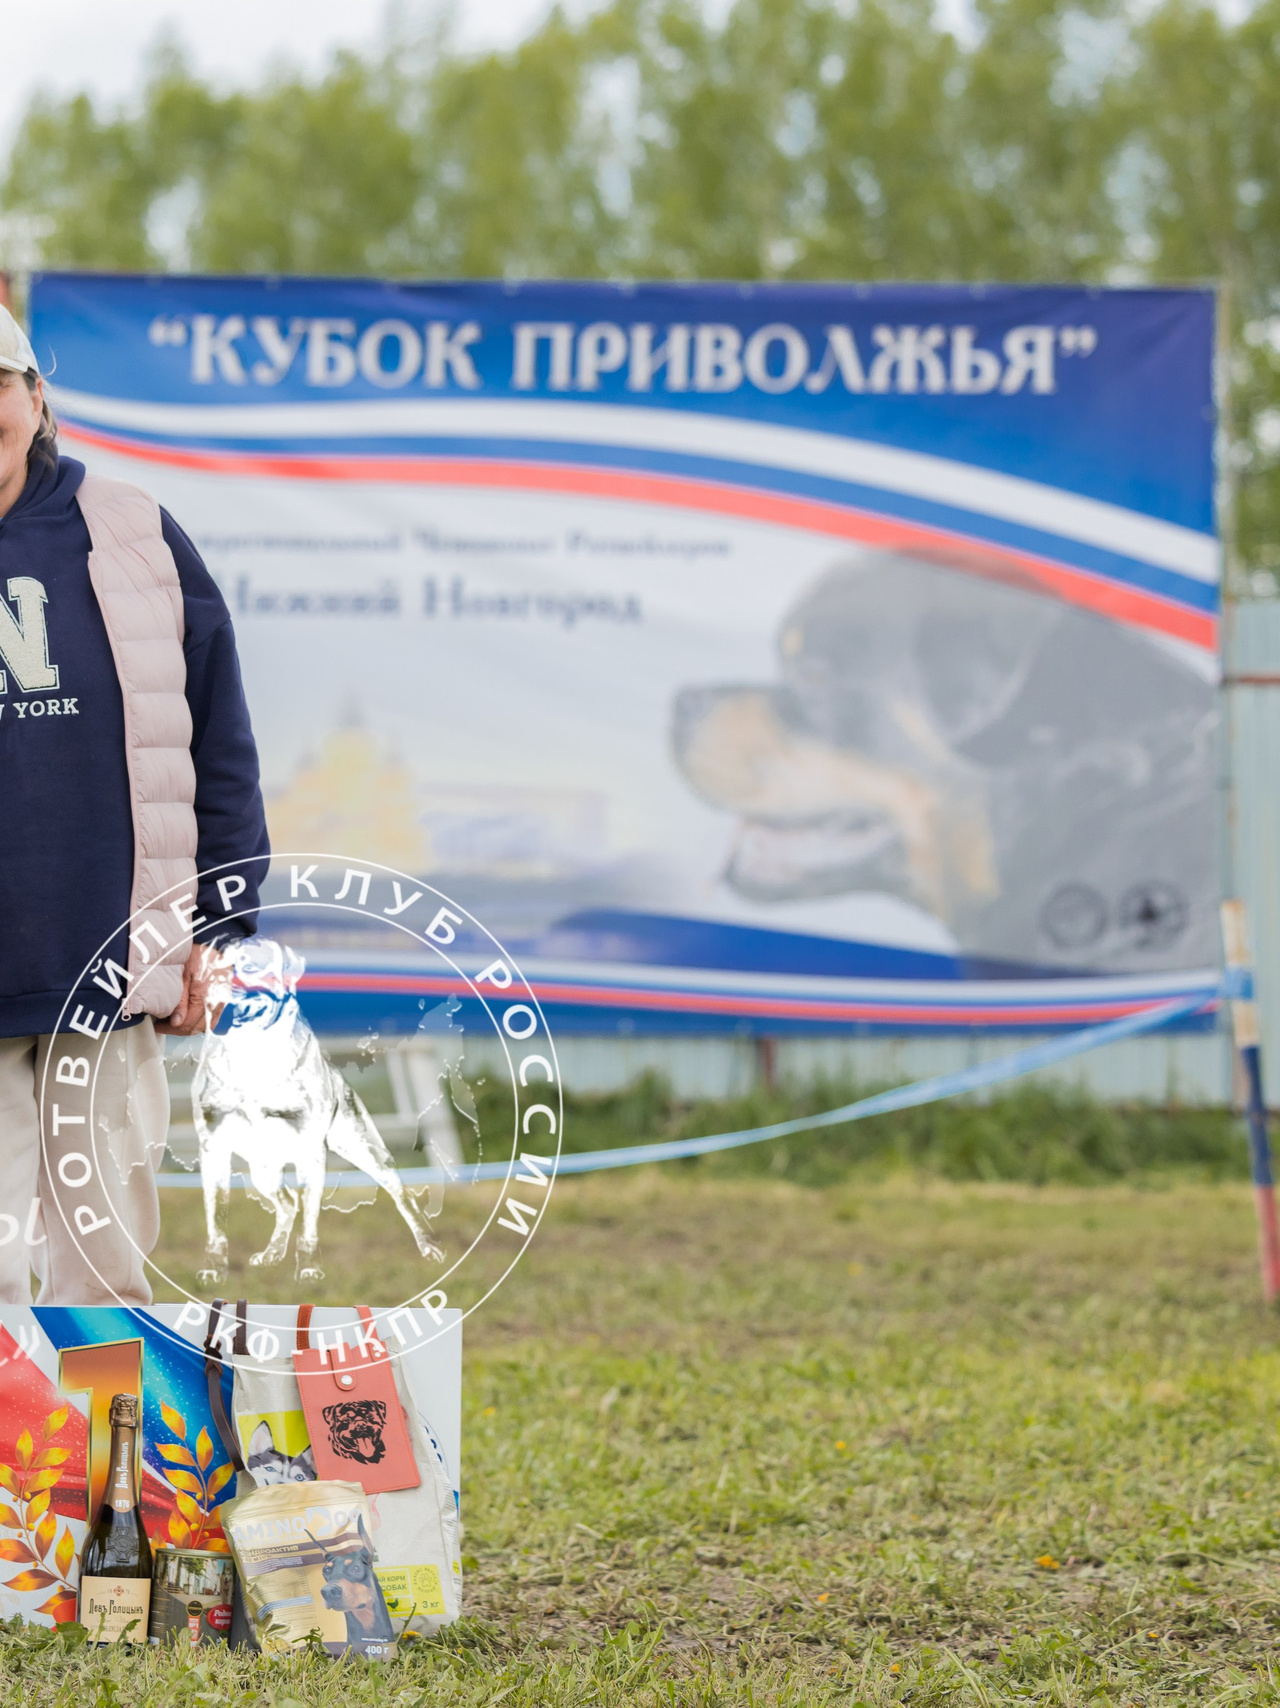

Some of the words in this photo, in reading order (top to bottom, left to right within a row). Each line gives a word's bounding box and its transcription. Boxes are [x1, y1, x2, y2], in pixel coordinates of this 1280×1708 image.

[148, 314, 483, 389] “КУБОК
[512, 322, 1097, 396] ПРИВОЛЖЬЯ”
[13, 698, 80, 718] YORK
[381, 1584, 407, 1592] СОБАК
[89, 1598, 107, 1614] Левъ
[108, 1600, 144, 1615] Голицынъ
[364, 1645, 382, 1654] 400
